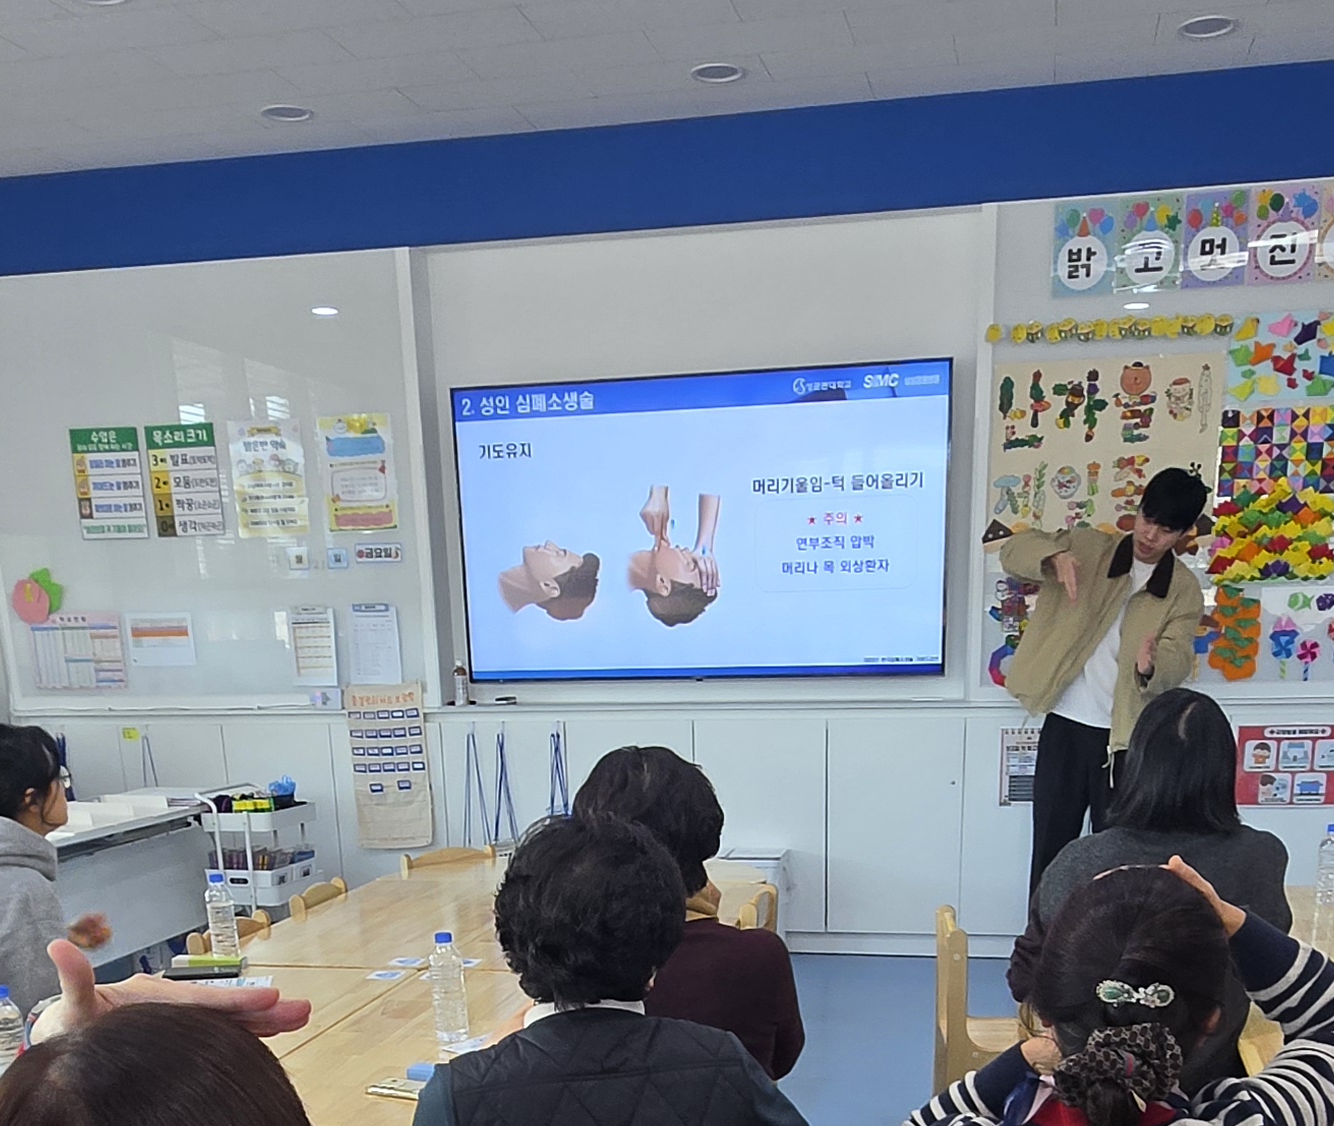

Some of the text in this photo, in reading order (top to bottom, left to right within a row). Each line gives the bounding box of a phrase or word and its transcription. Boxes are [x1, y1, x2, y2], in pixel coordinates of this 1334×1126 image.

[461, 391, 594, 416] 2. 성인 심폐소생술
[479, 442, 532, 459] 기도유지
[752, 471, 924, 494] 머리기울임-턱 들어올리기
[823, 511, 849, 526] 주의
[796, 534, 875, 551] 연부조직 압박
[365, 547, 392, 559] 금요일
[782, 558, 890, 575] 머리나 목 외상환자
